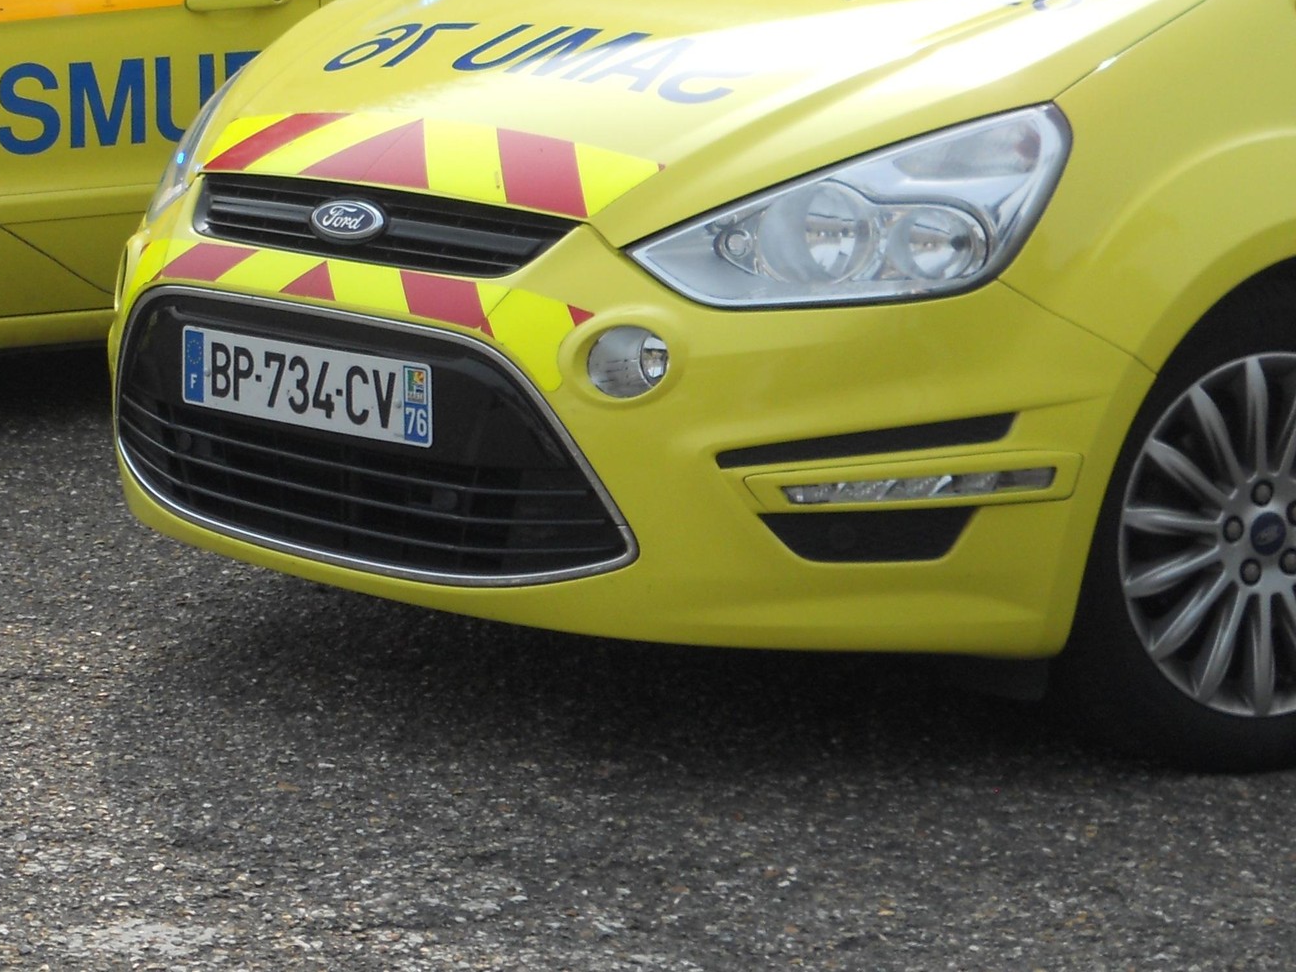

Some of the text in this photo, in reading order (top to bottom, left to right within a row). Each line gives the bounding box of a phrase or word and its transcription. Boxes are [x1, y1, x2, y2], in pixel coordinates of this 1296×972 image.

[322, 205, 365, 230] Ford
[189, 342, 427, 437] F BP-734-CV 76
